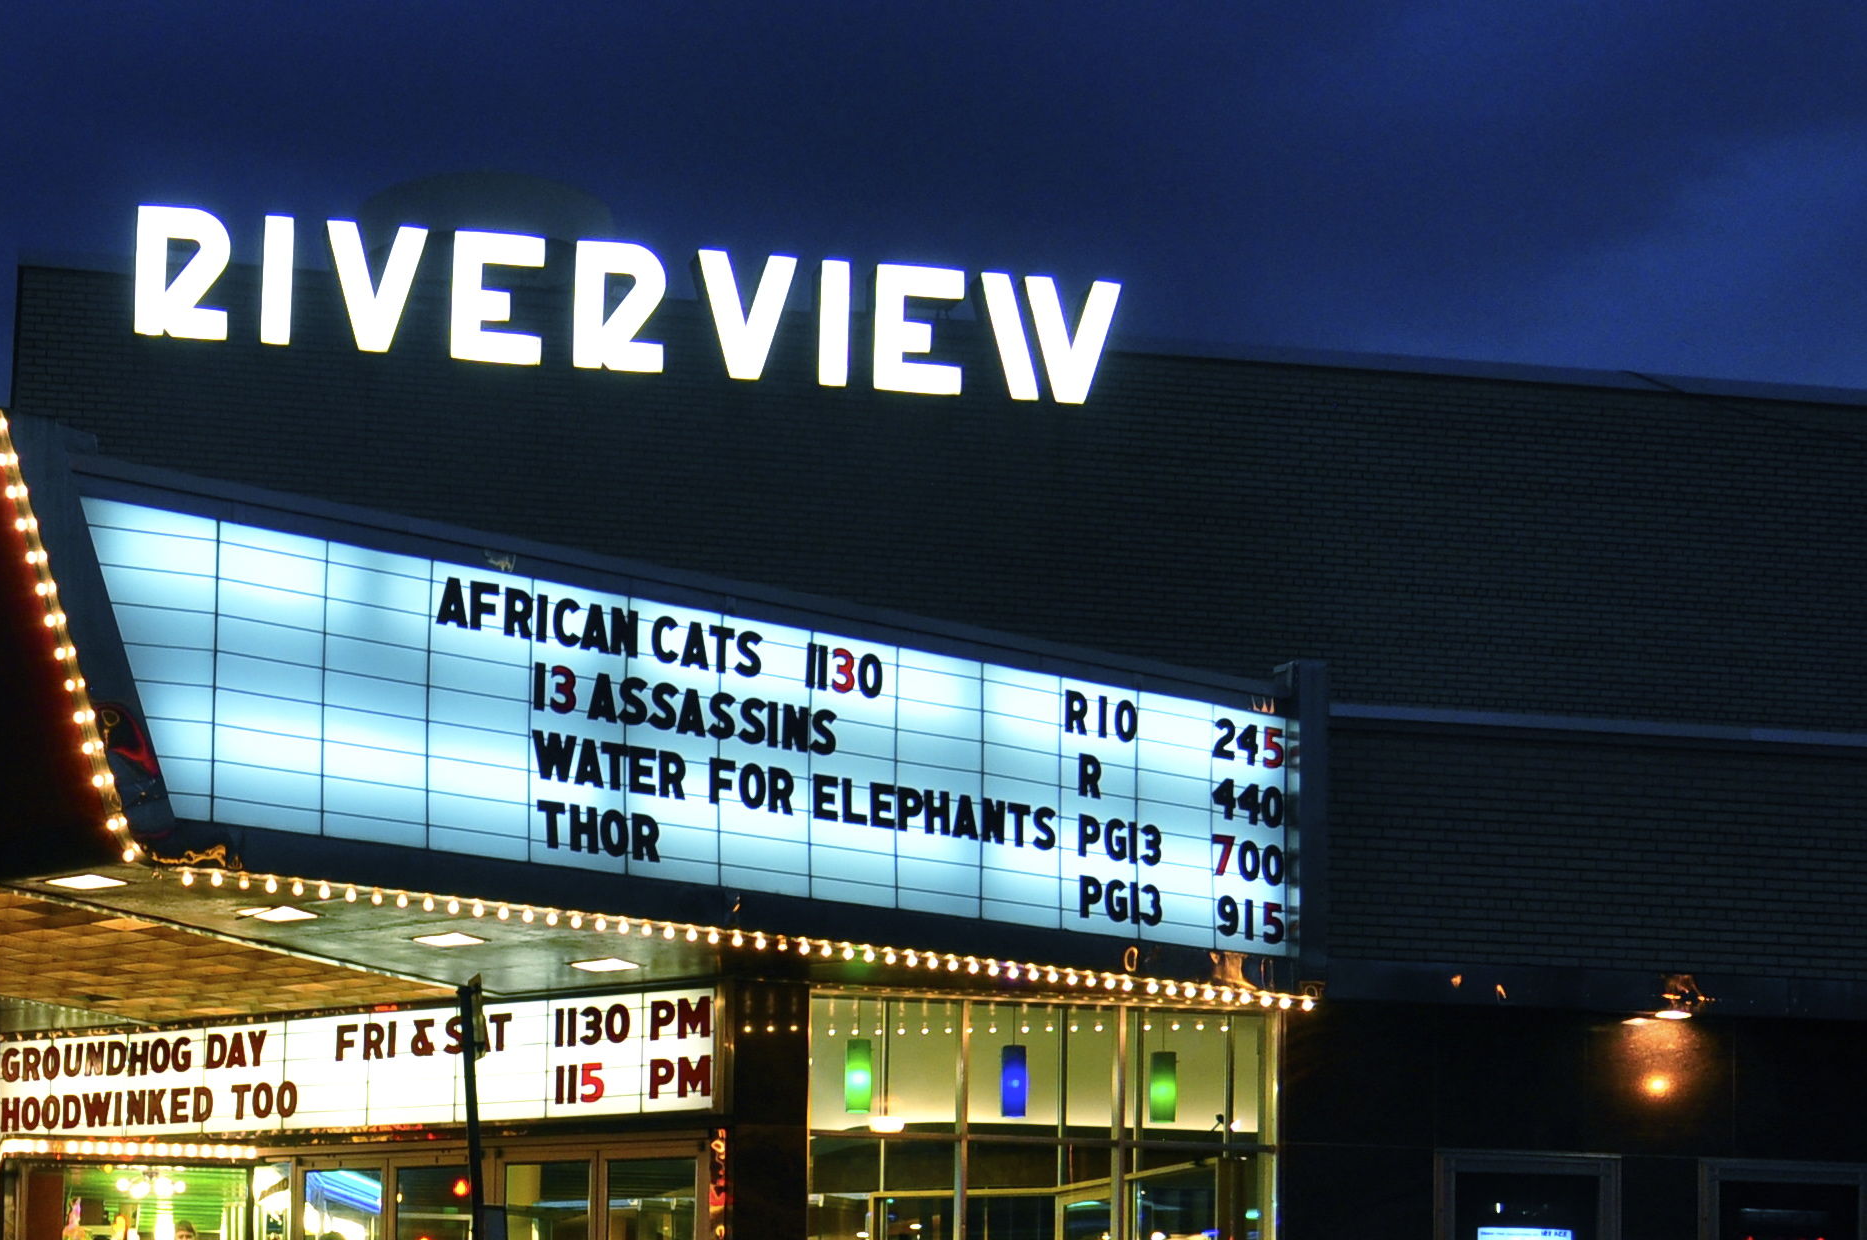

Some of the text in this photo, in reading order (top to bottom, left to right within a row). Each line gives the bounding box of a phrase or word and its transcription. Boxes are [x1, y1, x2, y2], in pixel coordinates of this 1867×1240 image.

[133, 203, 1122, 405] RIVERVIEW
[435, 576, 639, 658] AFRICAN
[651, 615, 763, 678] CATS
[805, 641, 883, 699] 1130
[1212, 717, 1284, 769] 245
[533, 661, 1285, 829] 13 ASSASSINS R 440
[532, 729, 1285, 887] WATER FOR ELEPHANTS PG13 700
[536, 799, 1285, 945] THOR PG13 915
[0, 1054, 711, 1132] HOODWINKED TOO 115 PM
[1, 1036, 192, 1083] GROUNDHOG
[205, 1029, 268, 1070] DAY
[335, 1020, 397, 1061] FRI
[410, 1018, 435, 1056] &
[554, 1002, 631, 1048] 1130
[650, 995, 711, 1041] PM
